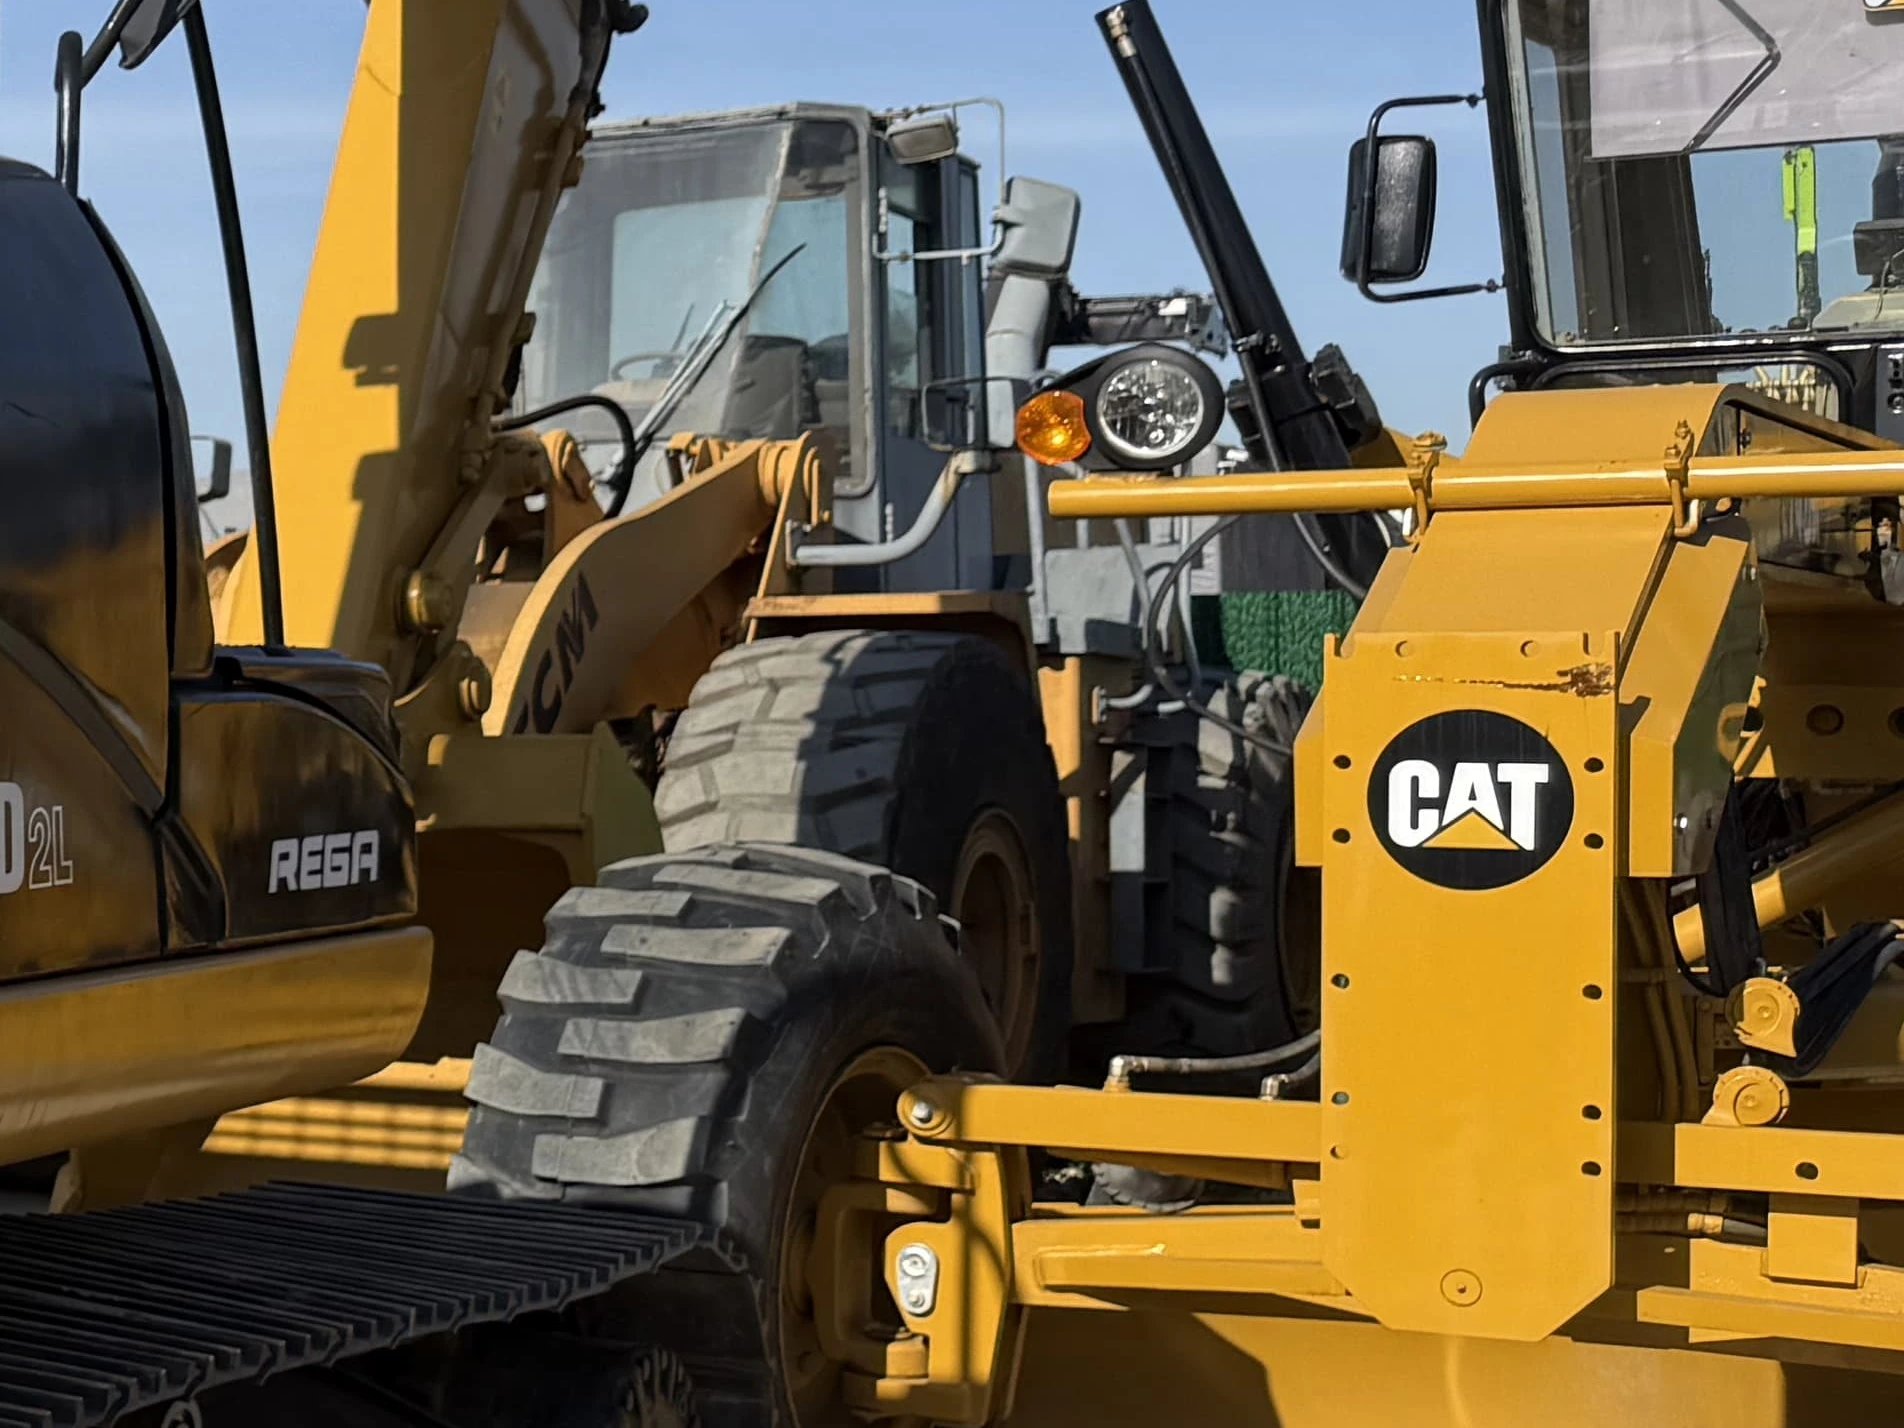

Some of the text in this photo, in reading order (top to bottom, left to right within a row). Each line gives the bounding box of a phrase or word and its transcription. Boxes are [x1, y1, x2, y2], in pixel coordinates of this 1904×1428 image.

[512, 569, 599, 734] CM
[1387, 760, 1549, 851] CAT
[268, 829, 380, 894] REGA
